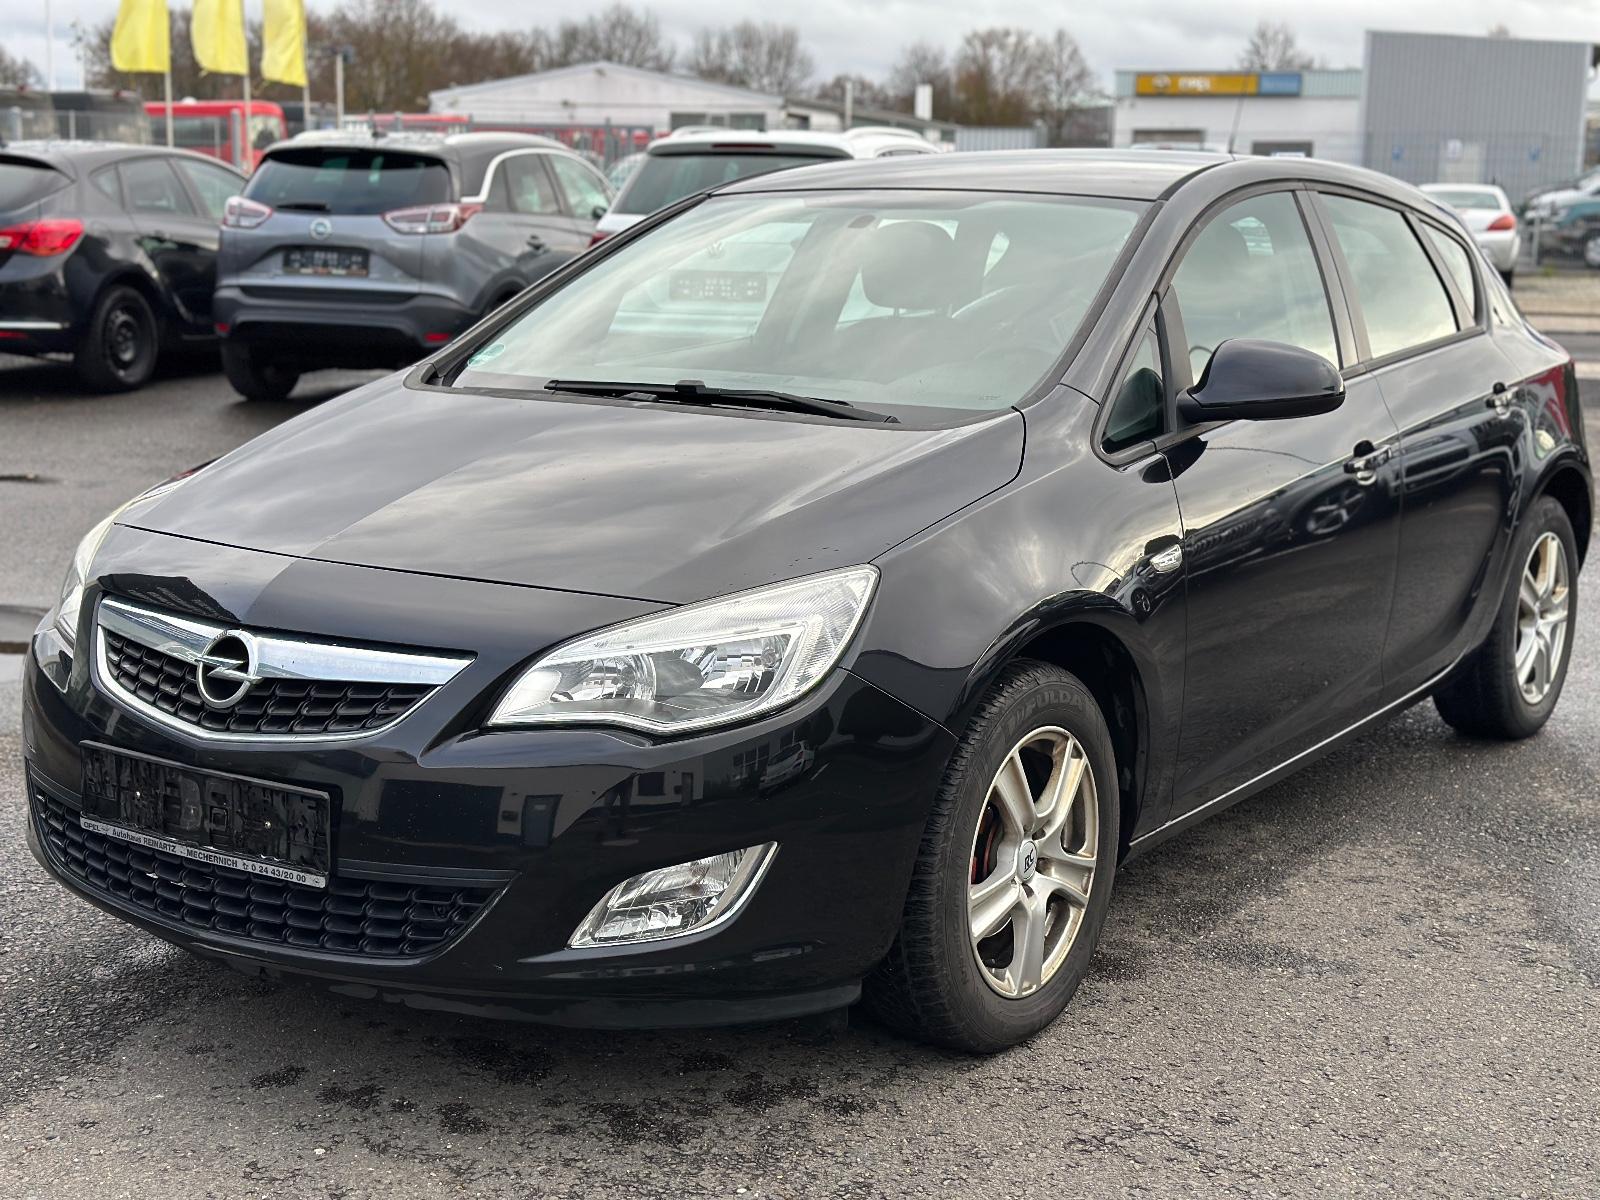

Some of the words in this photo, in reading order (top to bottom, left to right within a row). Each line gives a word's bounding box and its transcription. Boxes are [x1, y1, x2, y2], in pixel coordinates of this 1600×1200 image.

[83, 821, 100, 832] OPEL
[112, 828, 142, 844] Autohaus
[143, 837, 177, 853] REINARTZ
[186, 848, 238, 868] MECHERNICH
[251, 863, 257, 872] 0
[258, 865, 269, 875] 24
[271, 868, 294, 880] 43/20
[296, 872, 307, 883] 00
